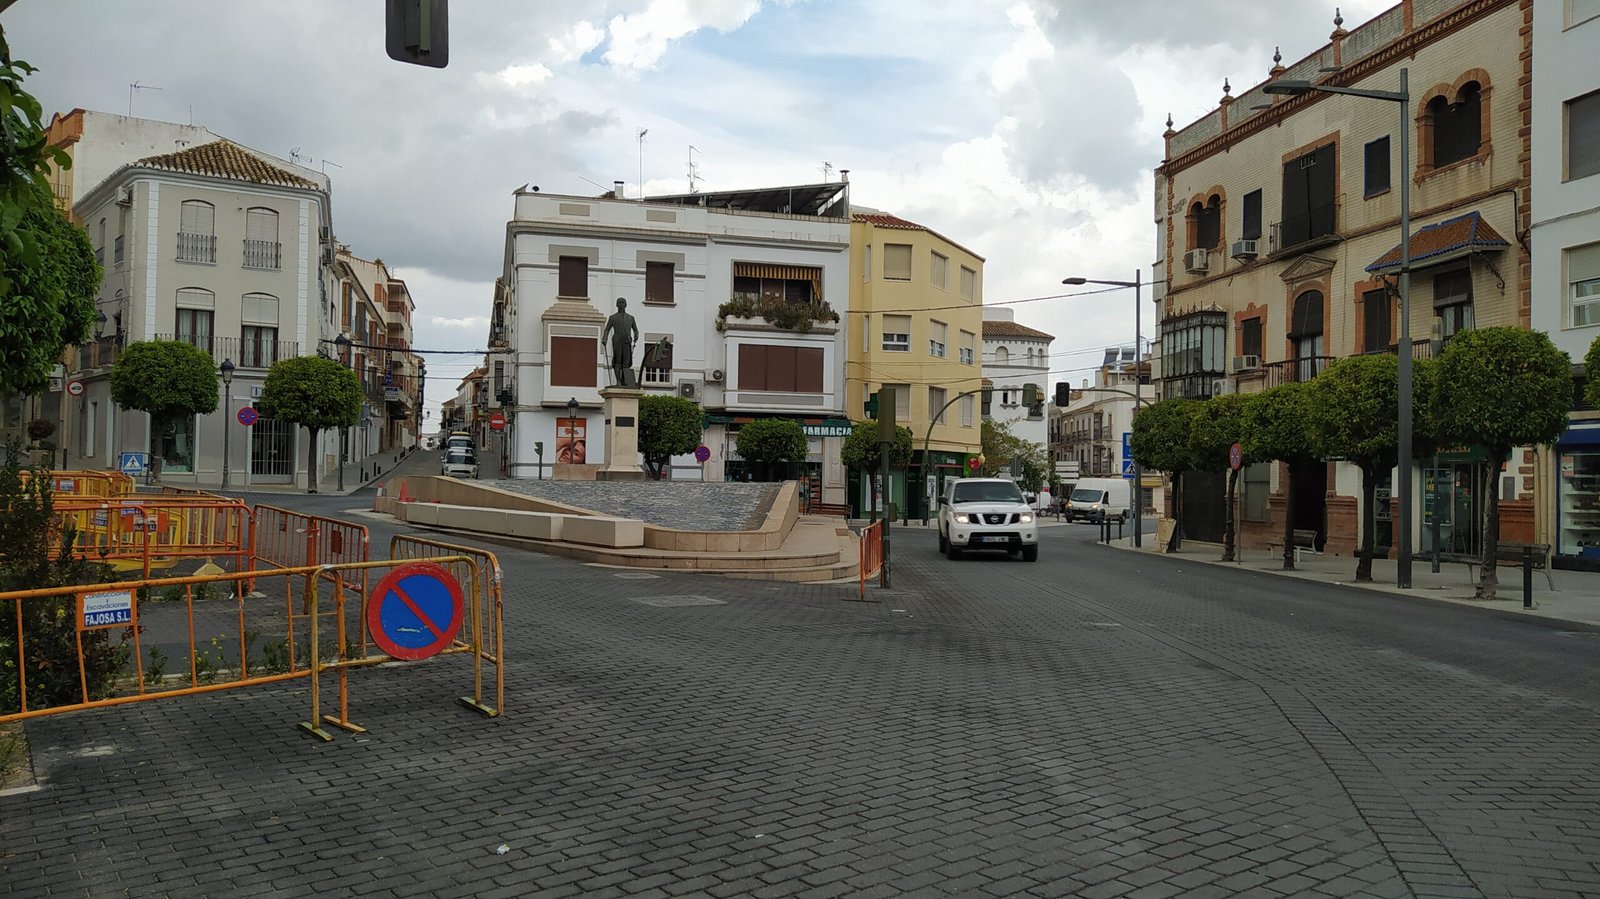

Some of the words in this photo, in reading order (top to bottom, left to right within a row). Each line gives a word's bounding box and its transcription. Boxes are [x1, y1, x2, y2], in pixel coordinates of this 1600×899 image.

[802, 426, 852, 436] FARMACIA
[86, 601, 129, 611] Excavaciones
[85, 612, 115, 626] FAJOSA
[116, 611, 131, 622] S.L.
